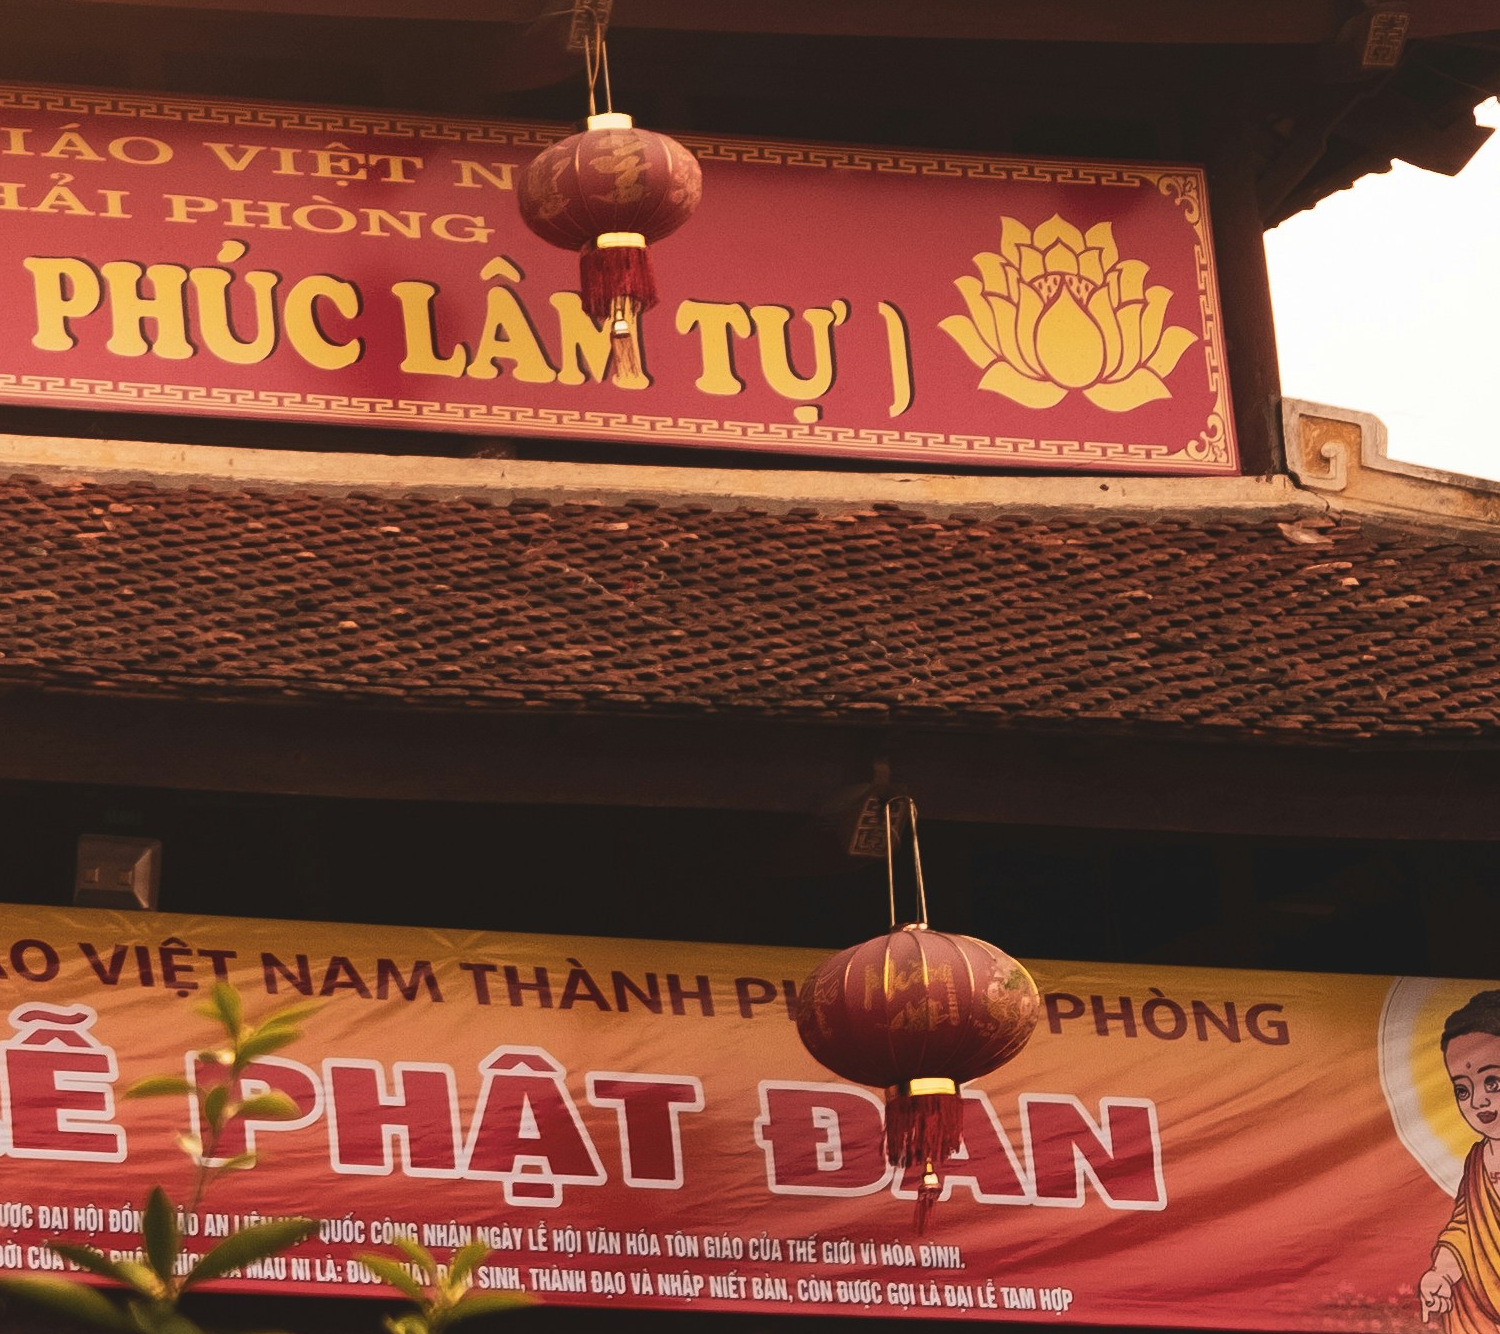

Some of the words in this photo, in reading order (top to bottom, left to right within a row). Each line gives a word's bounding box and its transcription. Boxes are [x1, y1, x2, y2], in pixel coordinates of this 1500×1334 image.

[203, 141, 423, 186] VIỆT
[163, 194, 496, 244] PHÒNG
[23, 240, 363, 370] PHÚC
[392, 256, 650, 390] LÂM
[676, 298, 847, 423] TỰ
[78, 936, 237, 998] VIỆT
[262, 952, 444, 1003] NAM
[460, 947, 711, 1019] THÀNH
[1046, 989, 1291, 1047] PHÒNG
[187, 1044, 705, 1208] PHẬT
[38, 1205, 68, 1234] ĐẠI
[74, 1203, 103, 1236] HỘI
[108, 1201, 145, 1234] ĐỒN
[204, 1214, 228, 1237] AN
[318, 1212, 365, 1245] QUỐC
[370, 1217, 418, 1246] CÔNG
[423, 1220, 472, 1254] NHẬN
[477, 1222, 522, 1250] NGÀY
[528, 1220, 549, 1252] LỄ
[553, 1224, 582, 1258] HỘI
[587, 1227, 621, 1255] VĂN
[626, 1228, 660, 1257] HÓA
[665, 1230, 699, 1258] TÔN
[704, 1231, 743, 1261] GIÁO
[749, 1230, 783, 1262] CỦA
[786, 1233, 819, 1263] THẾ
[822, 1238, 856, 1265] GIỚI
[860, 1238, 878, 1265] VÌ
[919, 1240, 966, 1269] BÌNH.
[292, 1258, 311, 1281] NI
[315, 1254, 343, 1283] LÀ:
[478, 1268, 526, 1294] SINH,
[529, 1264, 587, 1293] THÀNH
[591, 1270, 626, 1299] ĐẠO
[630, 1269, 652, 1295] VÀ
[657, 1269, 703, 1303] NHẬP
[709, 1270, 747, 1299] NIẾT
[752, 1273, 793, 1303] BÀN,
[797, 1274, 833, 1303] CÒN
[836, 1278, 882, 1309] ĐƯỢC
[887, 1283, 916, 1311] GỌI
[919, 1280, 942, 1307] LÀ
[944, 1285, 974, 1313] ĐẠI
[977, 1278, 998, 1308] LỄ
[1000, 1287, 1036, 1311] TAM
[1040, 1286, 1073, 1316] HỢP
